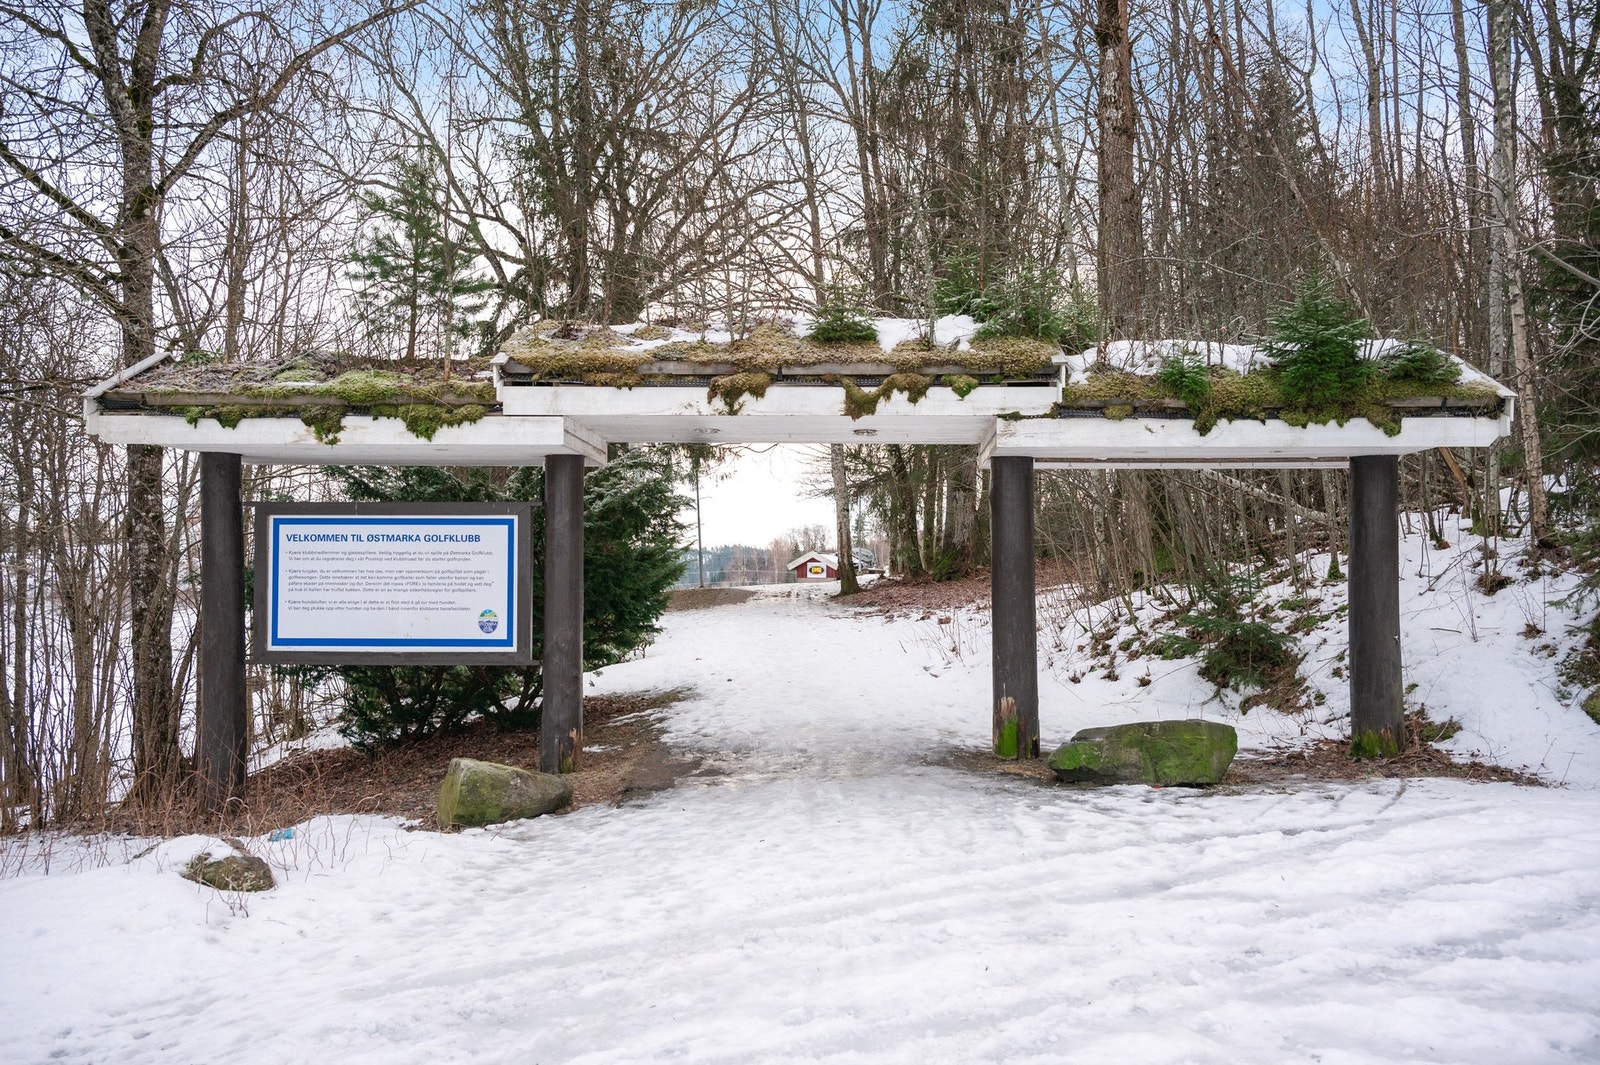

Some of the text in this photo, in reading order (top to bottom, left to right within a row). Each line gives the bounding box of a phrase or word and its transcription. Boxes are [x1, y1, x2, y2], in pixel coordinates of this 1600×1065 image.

[286, 534, 481, 542] VELKOMMEN TIL ØSTMARKA GOLFKLUBB
